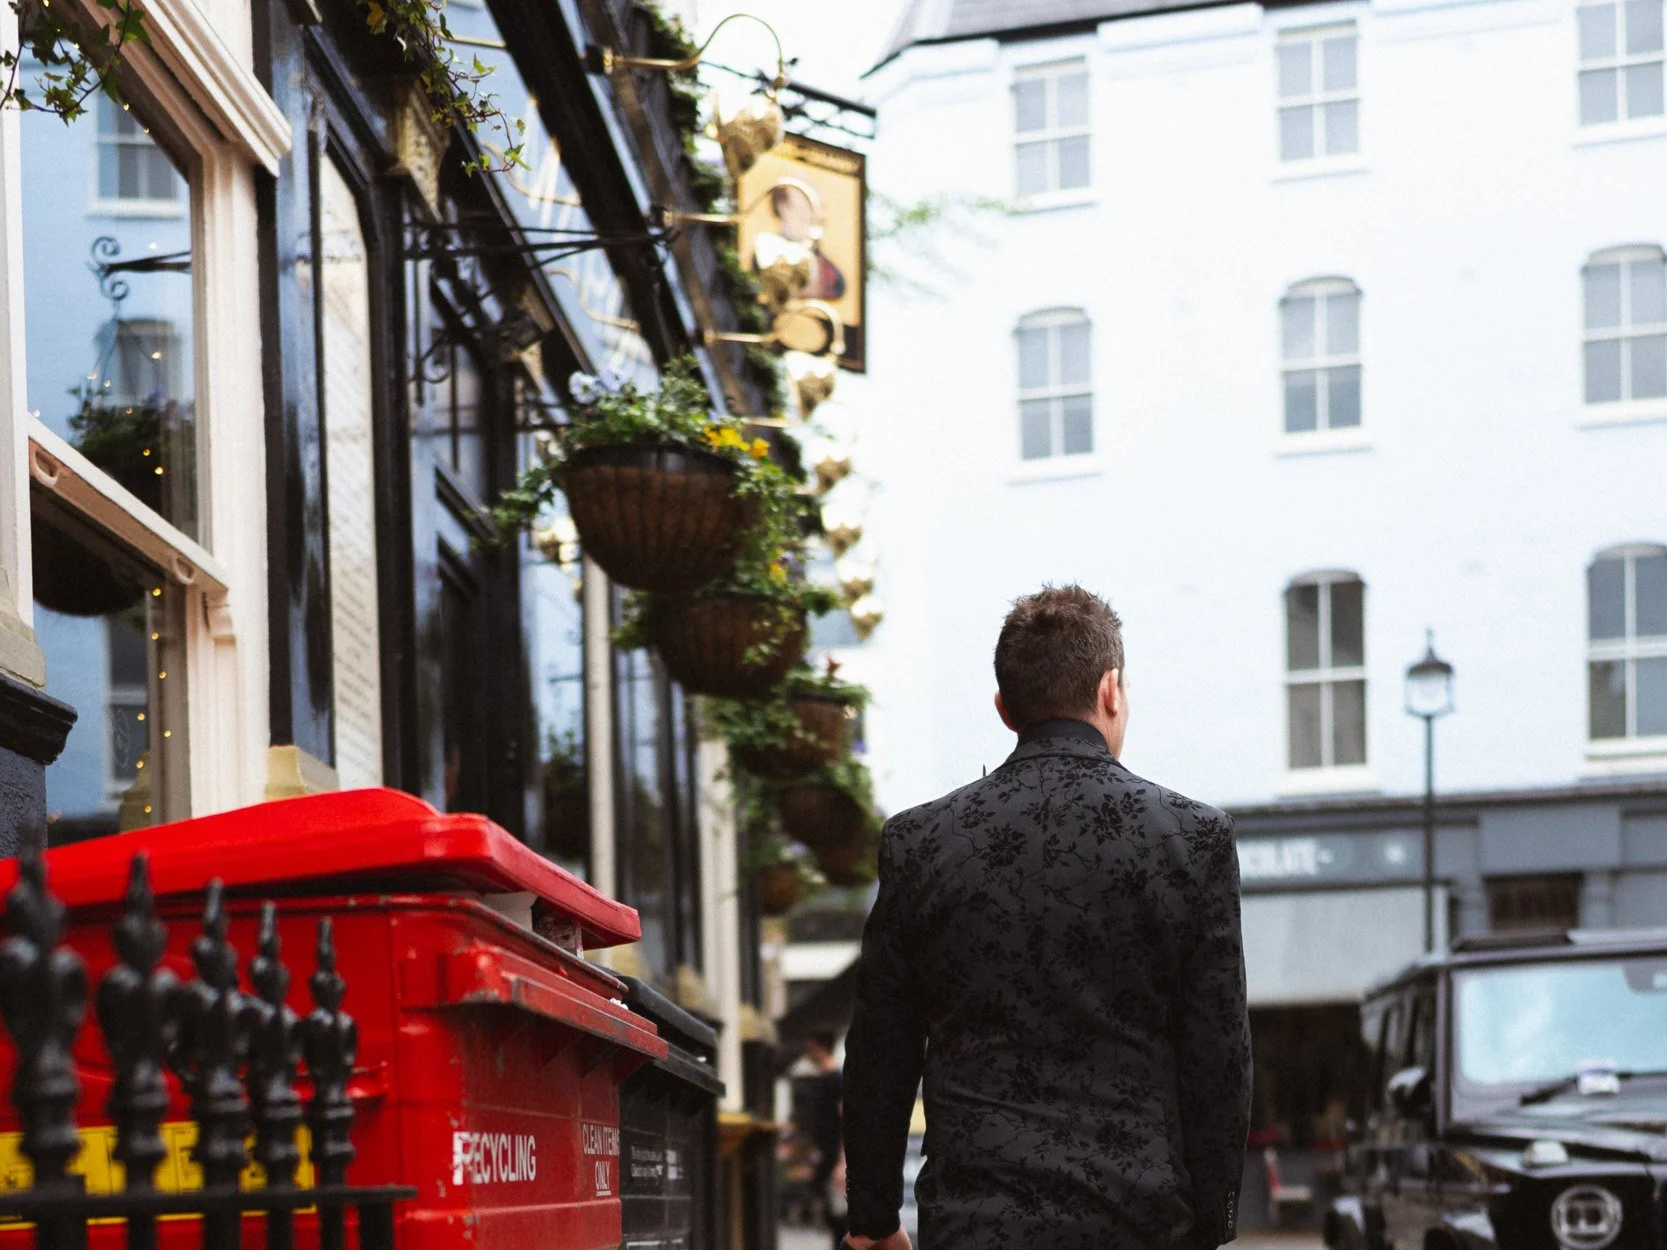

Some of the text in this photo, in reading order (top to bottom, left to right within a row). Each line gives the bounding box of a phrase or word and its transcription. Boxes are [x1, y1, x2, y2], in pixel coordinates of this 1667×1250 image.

[583, 1123, 602, 1155] CLEAN
[452, 1131, 537, 1185] RECYCLING
[595, 1161, 611, 1191] ONLY
